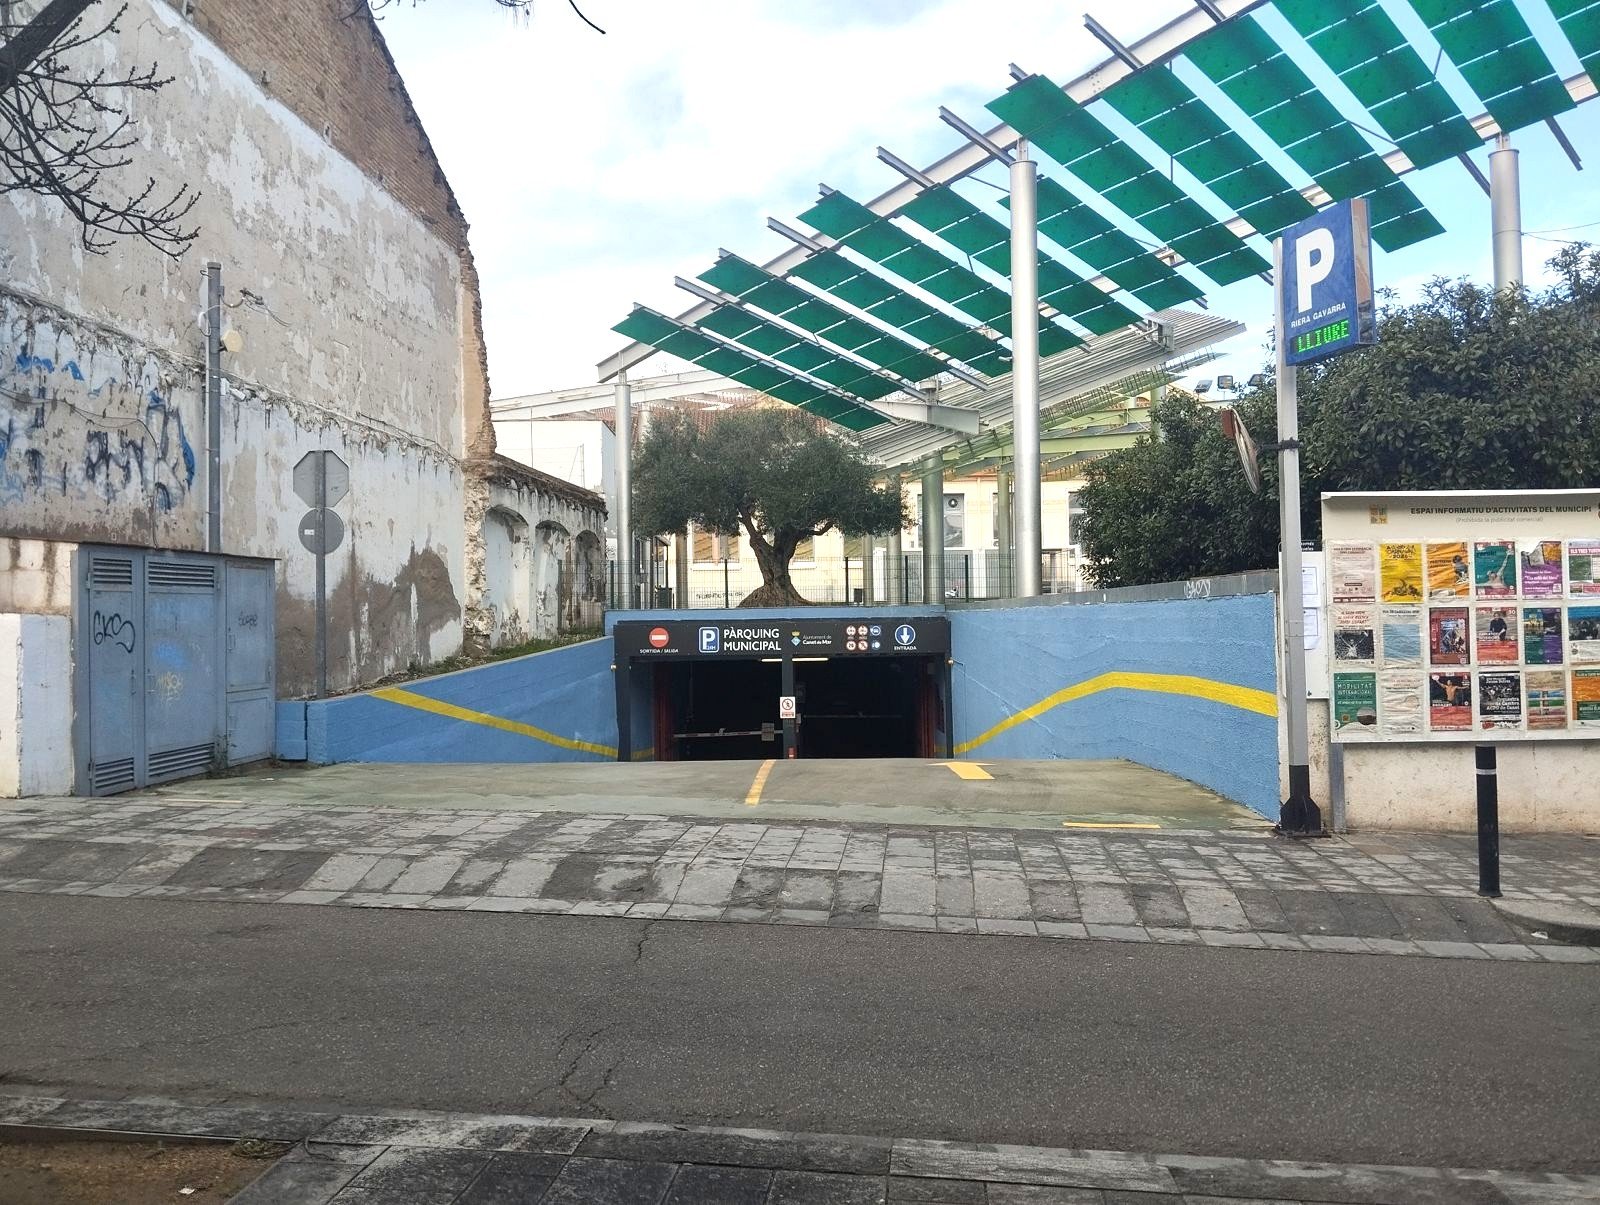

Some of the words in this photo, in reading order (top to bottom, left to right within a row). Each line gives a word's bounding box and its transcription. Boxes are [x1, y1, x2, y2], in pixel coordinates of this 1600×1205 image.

[1296, 228, 1335, 313] P
[1291, 315, 1311, 328] RIERA
[1313, 302, 1346, 321] GAVARRA
[1298, 319, 1350, 353] LLIURE
[1485, 506, 1538, 514] D'ACTIVITATS
[702, 629, 716, 650] P
[723, 626, 780, 639] PÀRQUING
[723, 641, 782, 651] MUNICIPAL
